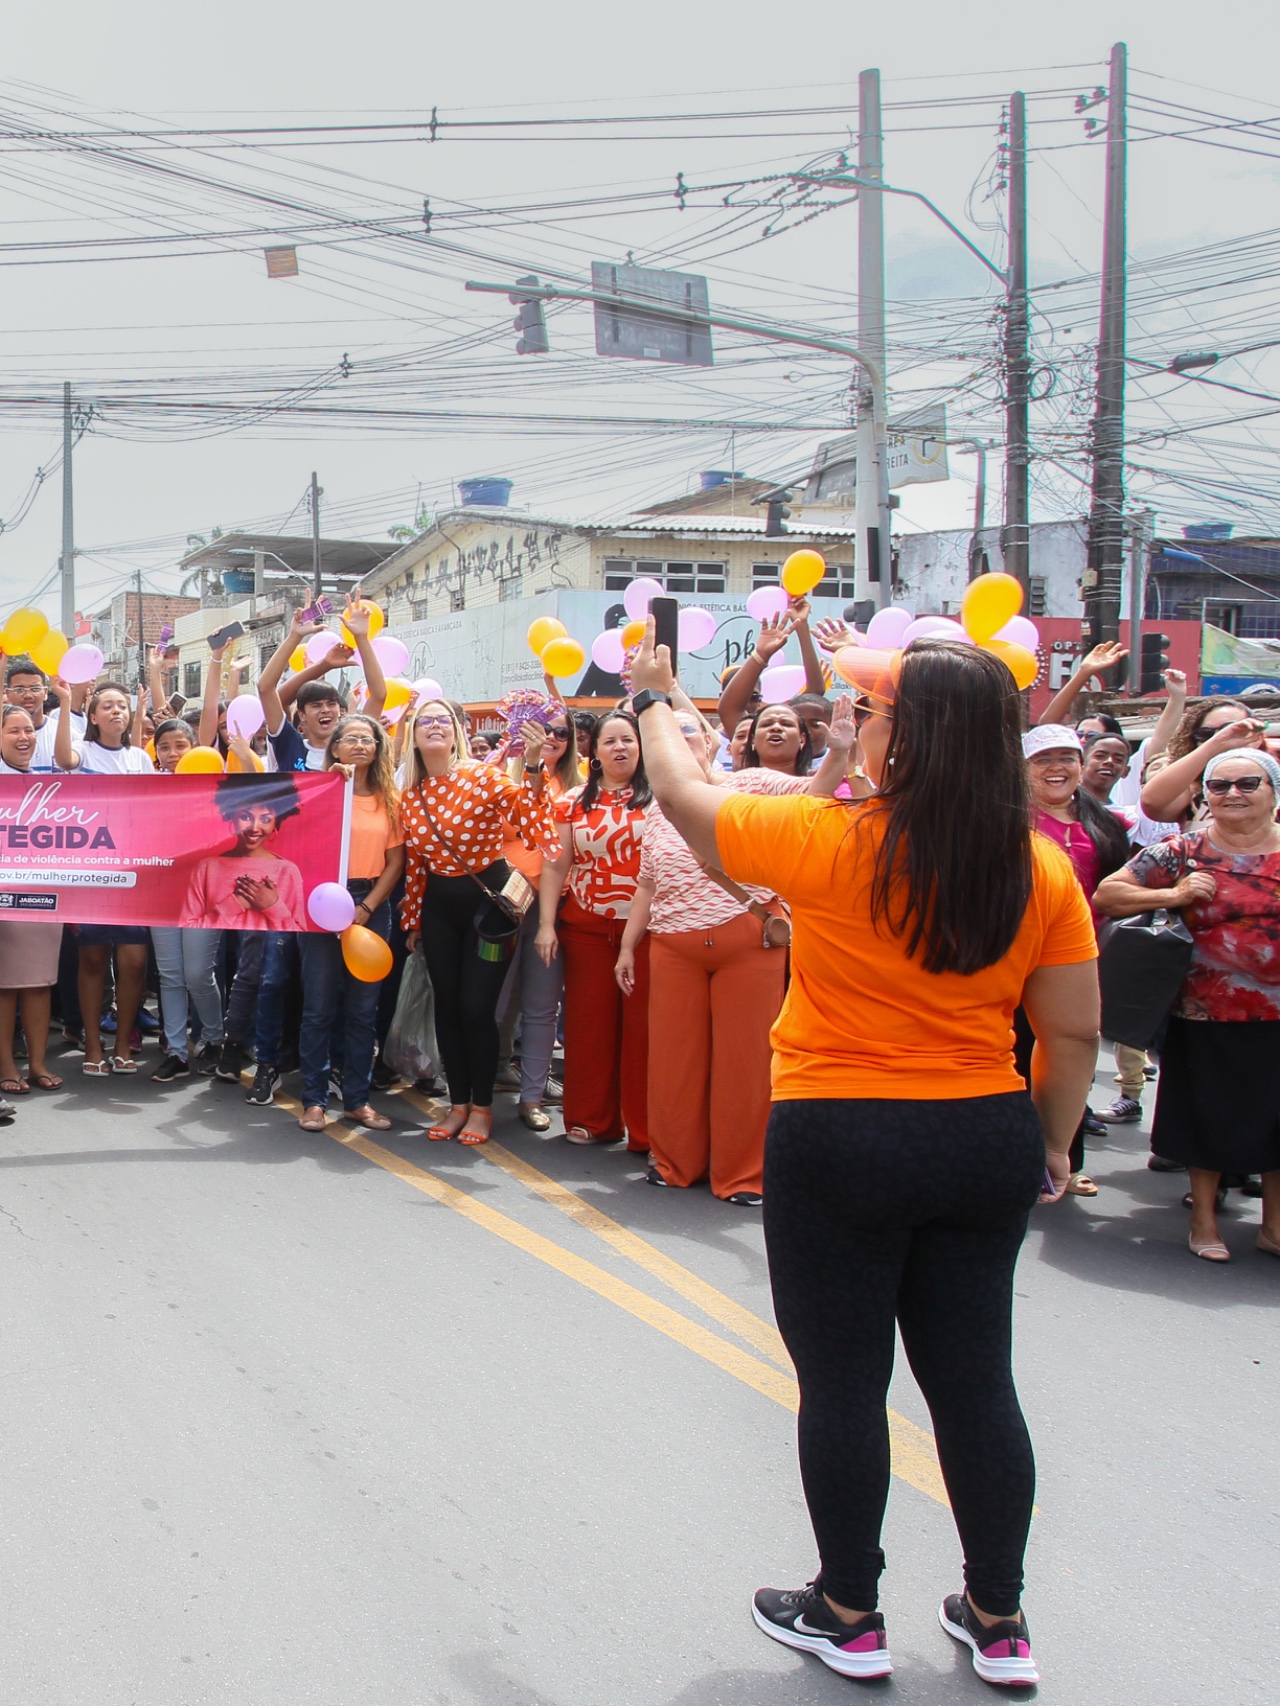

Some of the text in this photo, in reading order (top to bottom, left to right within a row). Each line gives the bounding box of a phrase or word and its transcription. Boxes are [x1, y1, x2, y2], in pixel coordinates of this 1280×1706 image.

[13, 854, 28, 864] de
[30, 854, 82, 865] violência
[83, 856, 120, 865] contra
[122, 857, 130, 865] a
[132, 856, 175, 867] mulher
